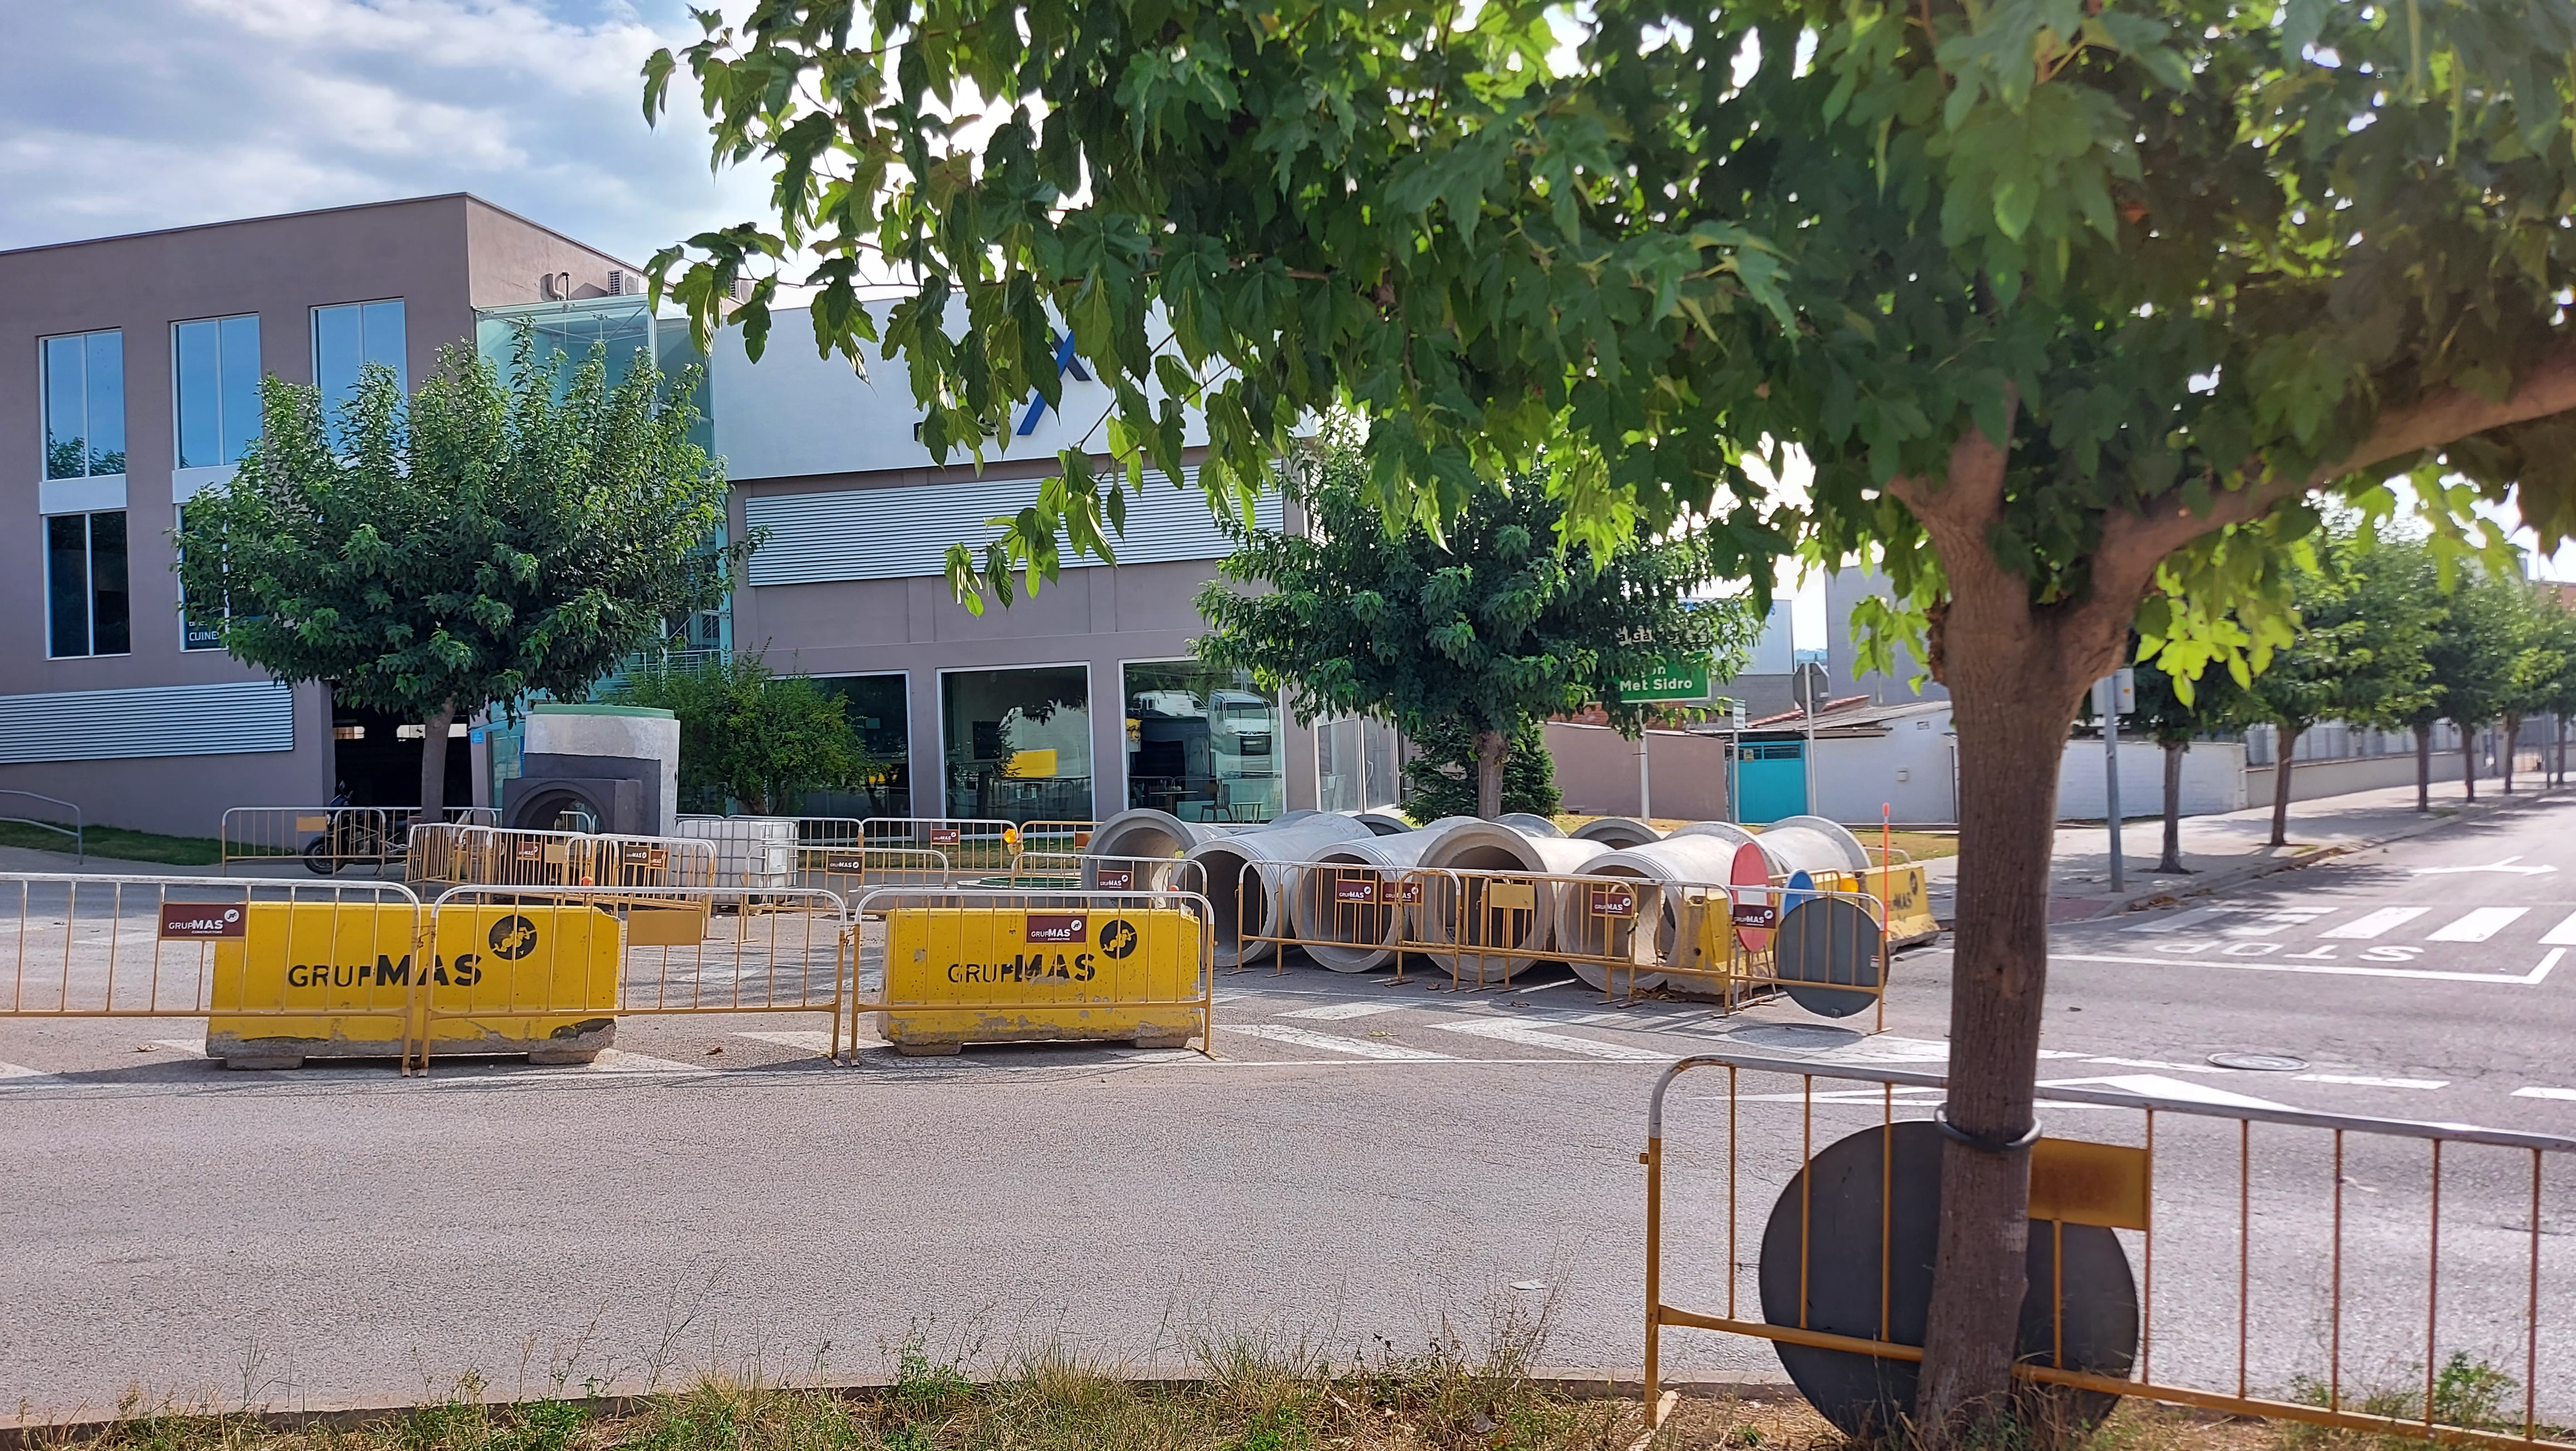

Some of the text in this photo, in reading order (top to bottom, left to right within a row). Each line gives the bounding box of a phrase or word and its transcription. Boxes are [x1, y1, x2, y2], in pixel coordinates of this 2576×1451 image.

[1619, 679, 1648, 692] Met
[1653, 678, 1693, 690] Sidro
[2153, 941, 2425, 962] STOP
